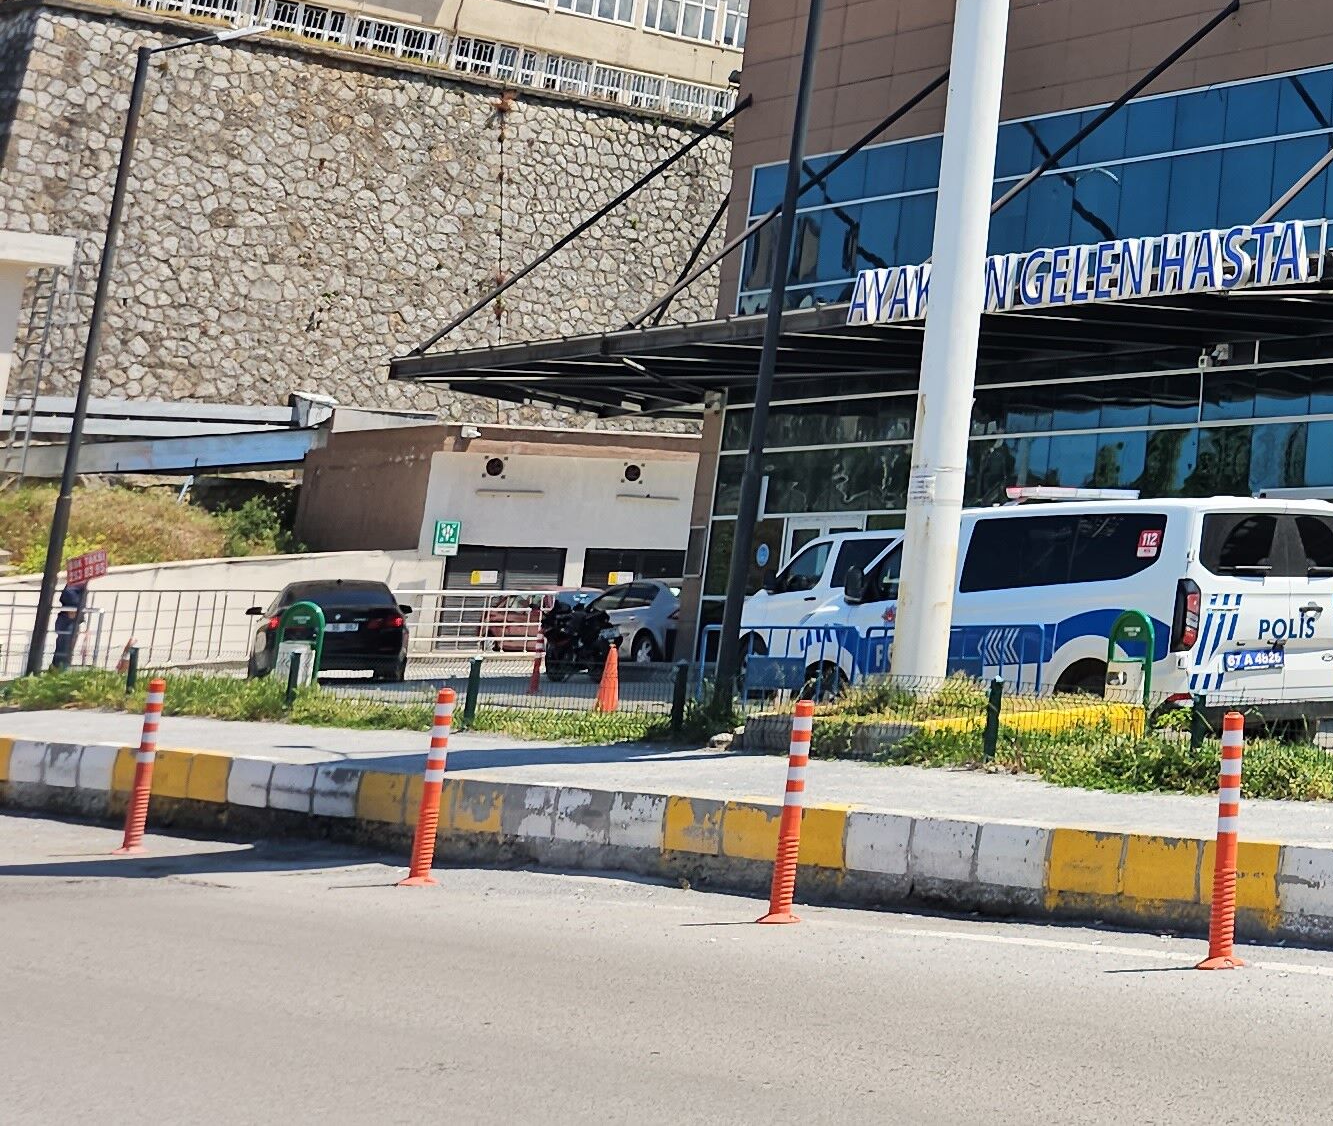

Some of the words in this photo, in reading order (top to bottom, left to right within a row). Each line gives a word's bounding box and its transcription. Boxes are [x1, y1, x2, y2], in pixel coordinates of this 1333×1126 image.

[847, 254, 1014, 324] AYAKN
[1020, 236, 1147, 306] GELEN
[1158, 219, 1310, 291] HASTA
[1141, 532, 1159, 547] 112
